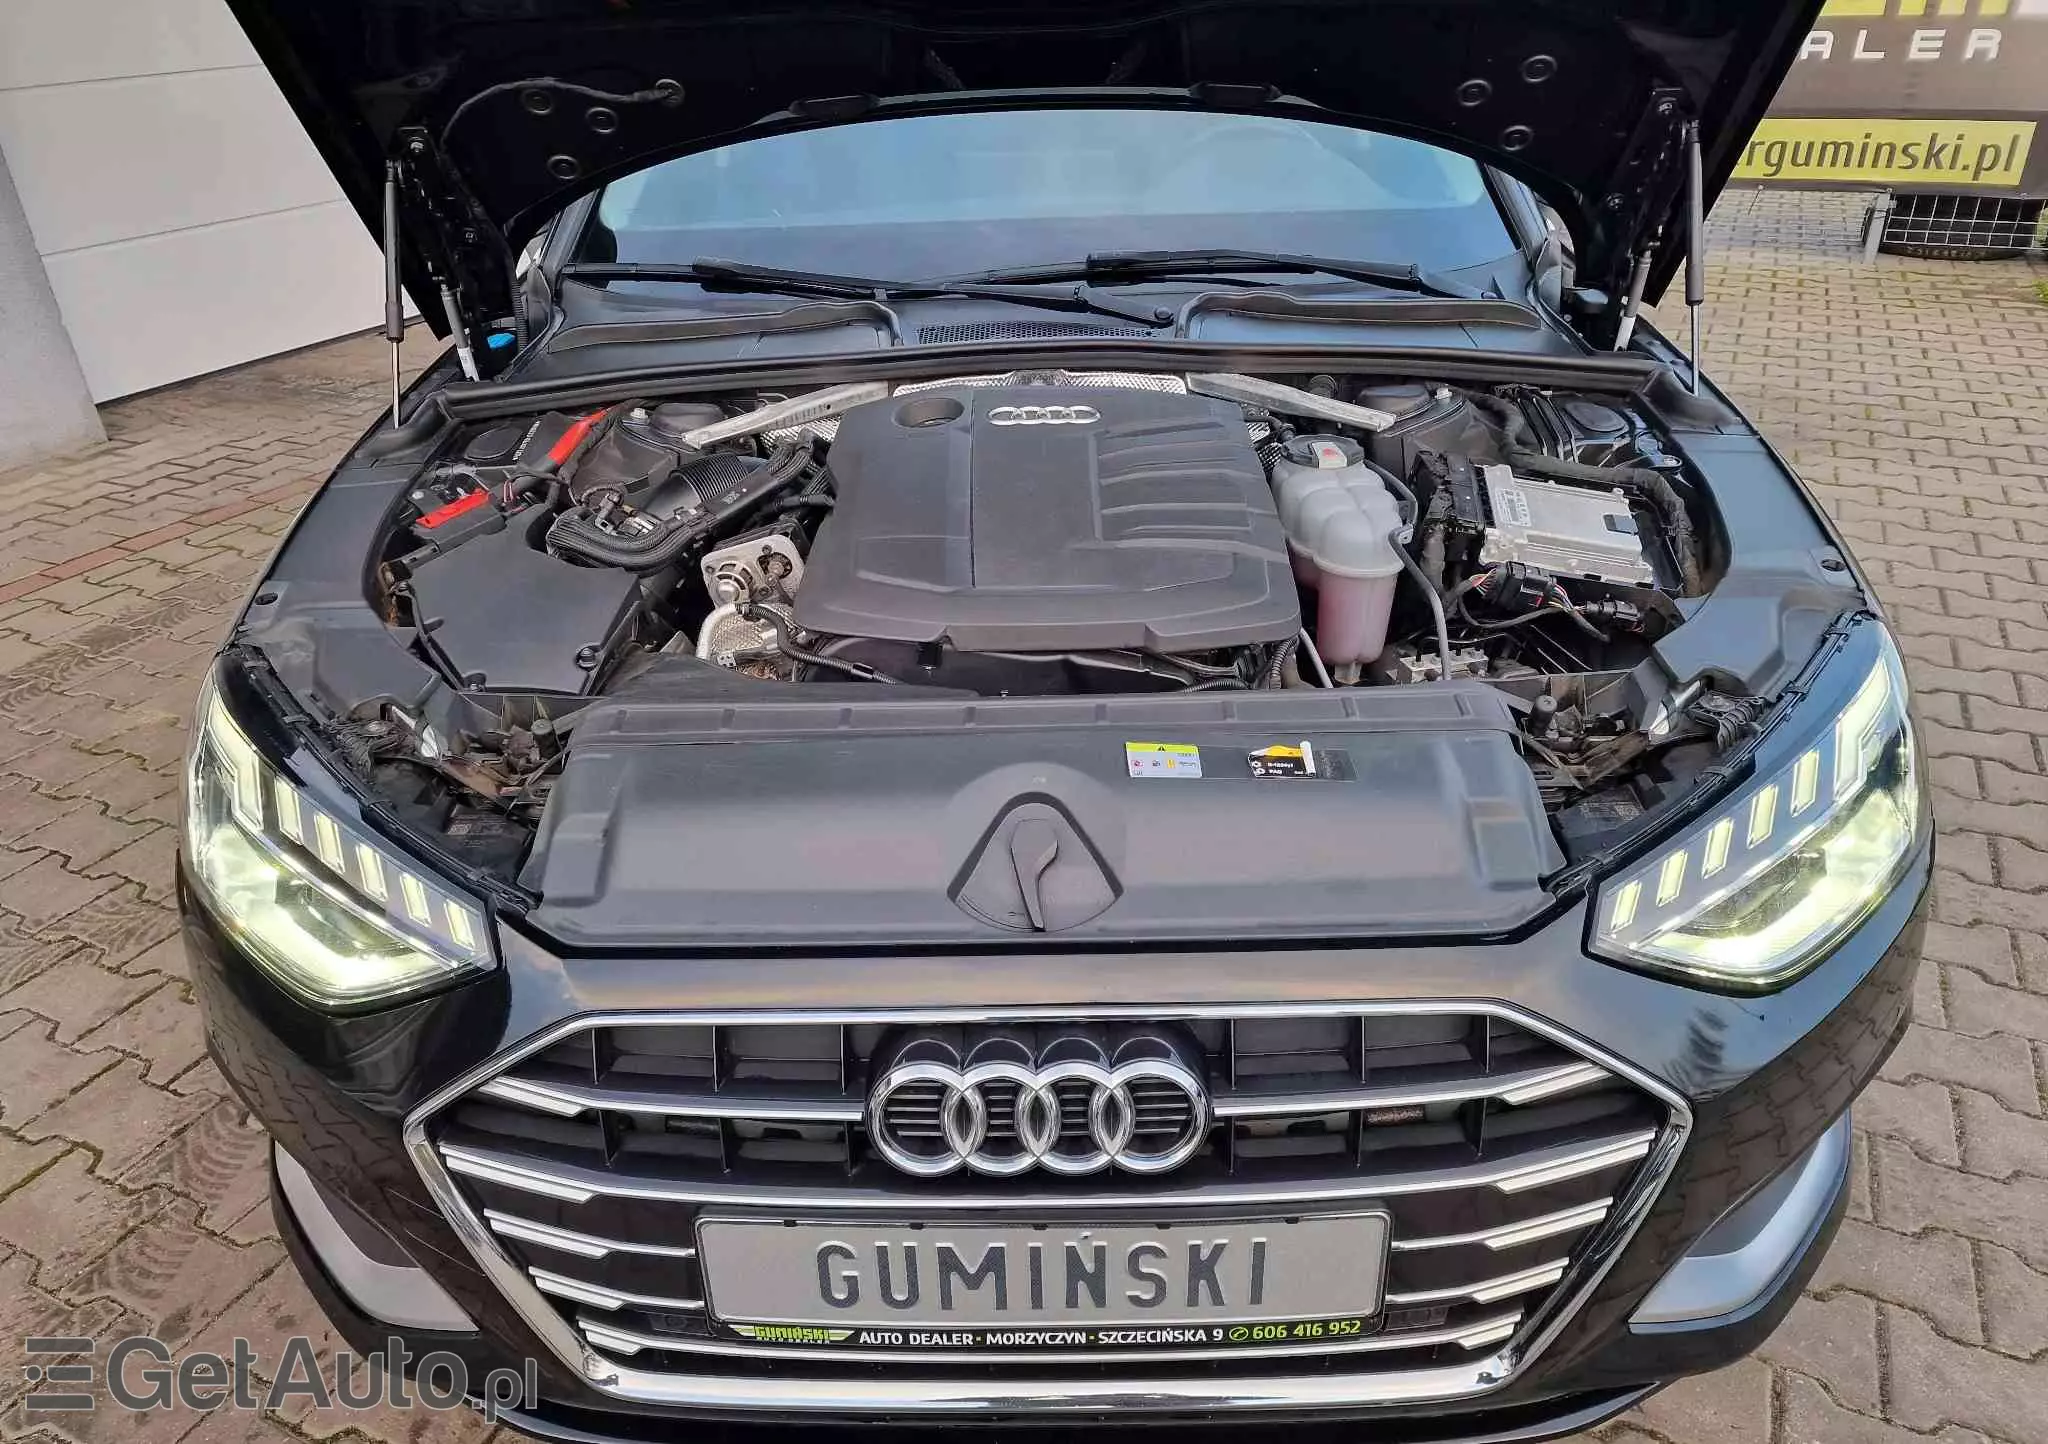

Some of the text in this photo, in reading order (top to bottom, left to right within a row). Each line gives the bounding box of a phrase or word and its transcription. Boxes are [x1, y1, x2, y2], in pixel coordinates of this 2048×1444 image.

[1738, 132, 2021, 182] rguminski.pl
[815, 1231, 1268, 1310] GUMIŃSKI
[859, 1319, 1362, 1345] AUTO DEALER MORZYCZYN SZCZECIŃSKA 9 606 416 952
